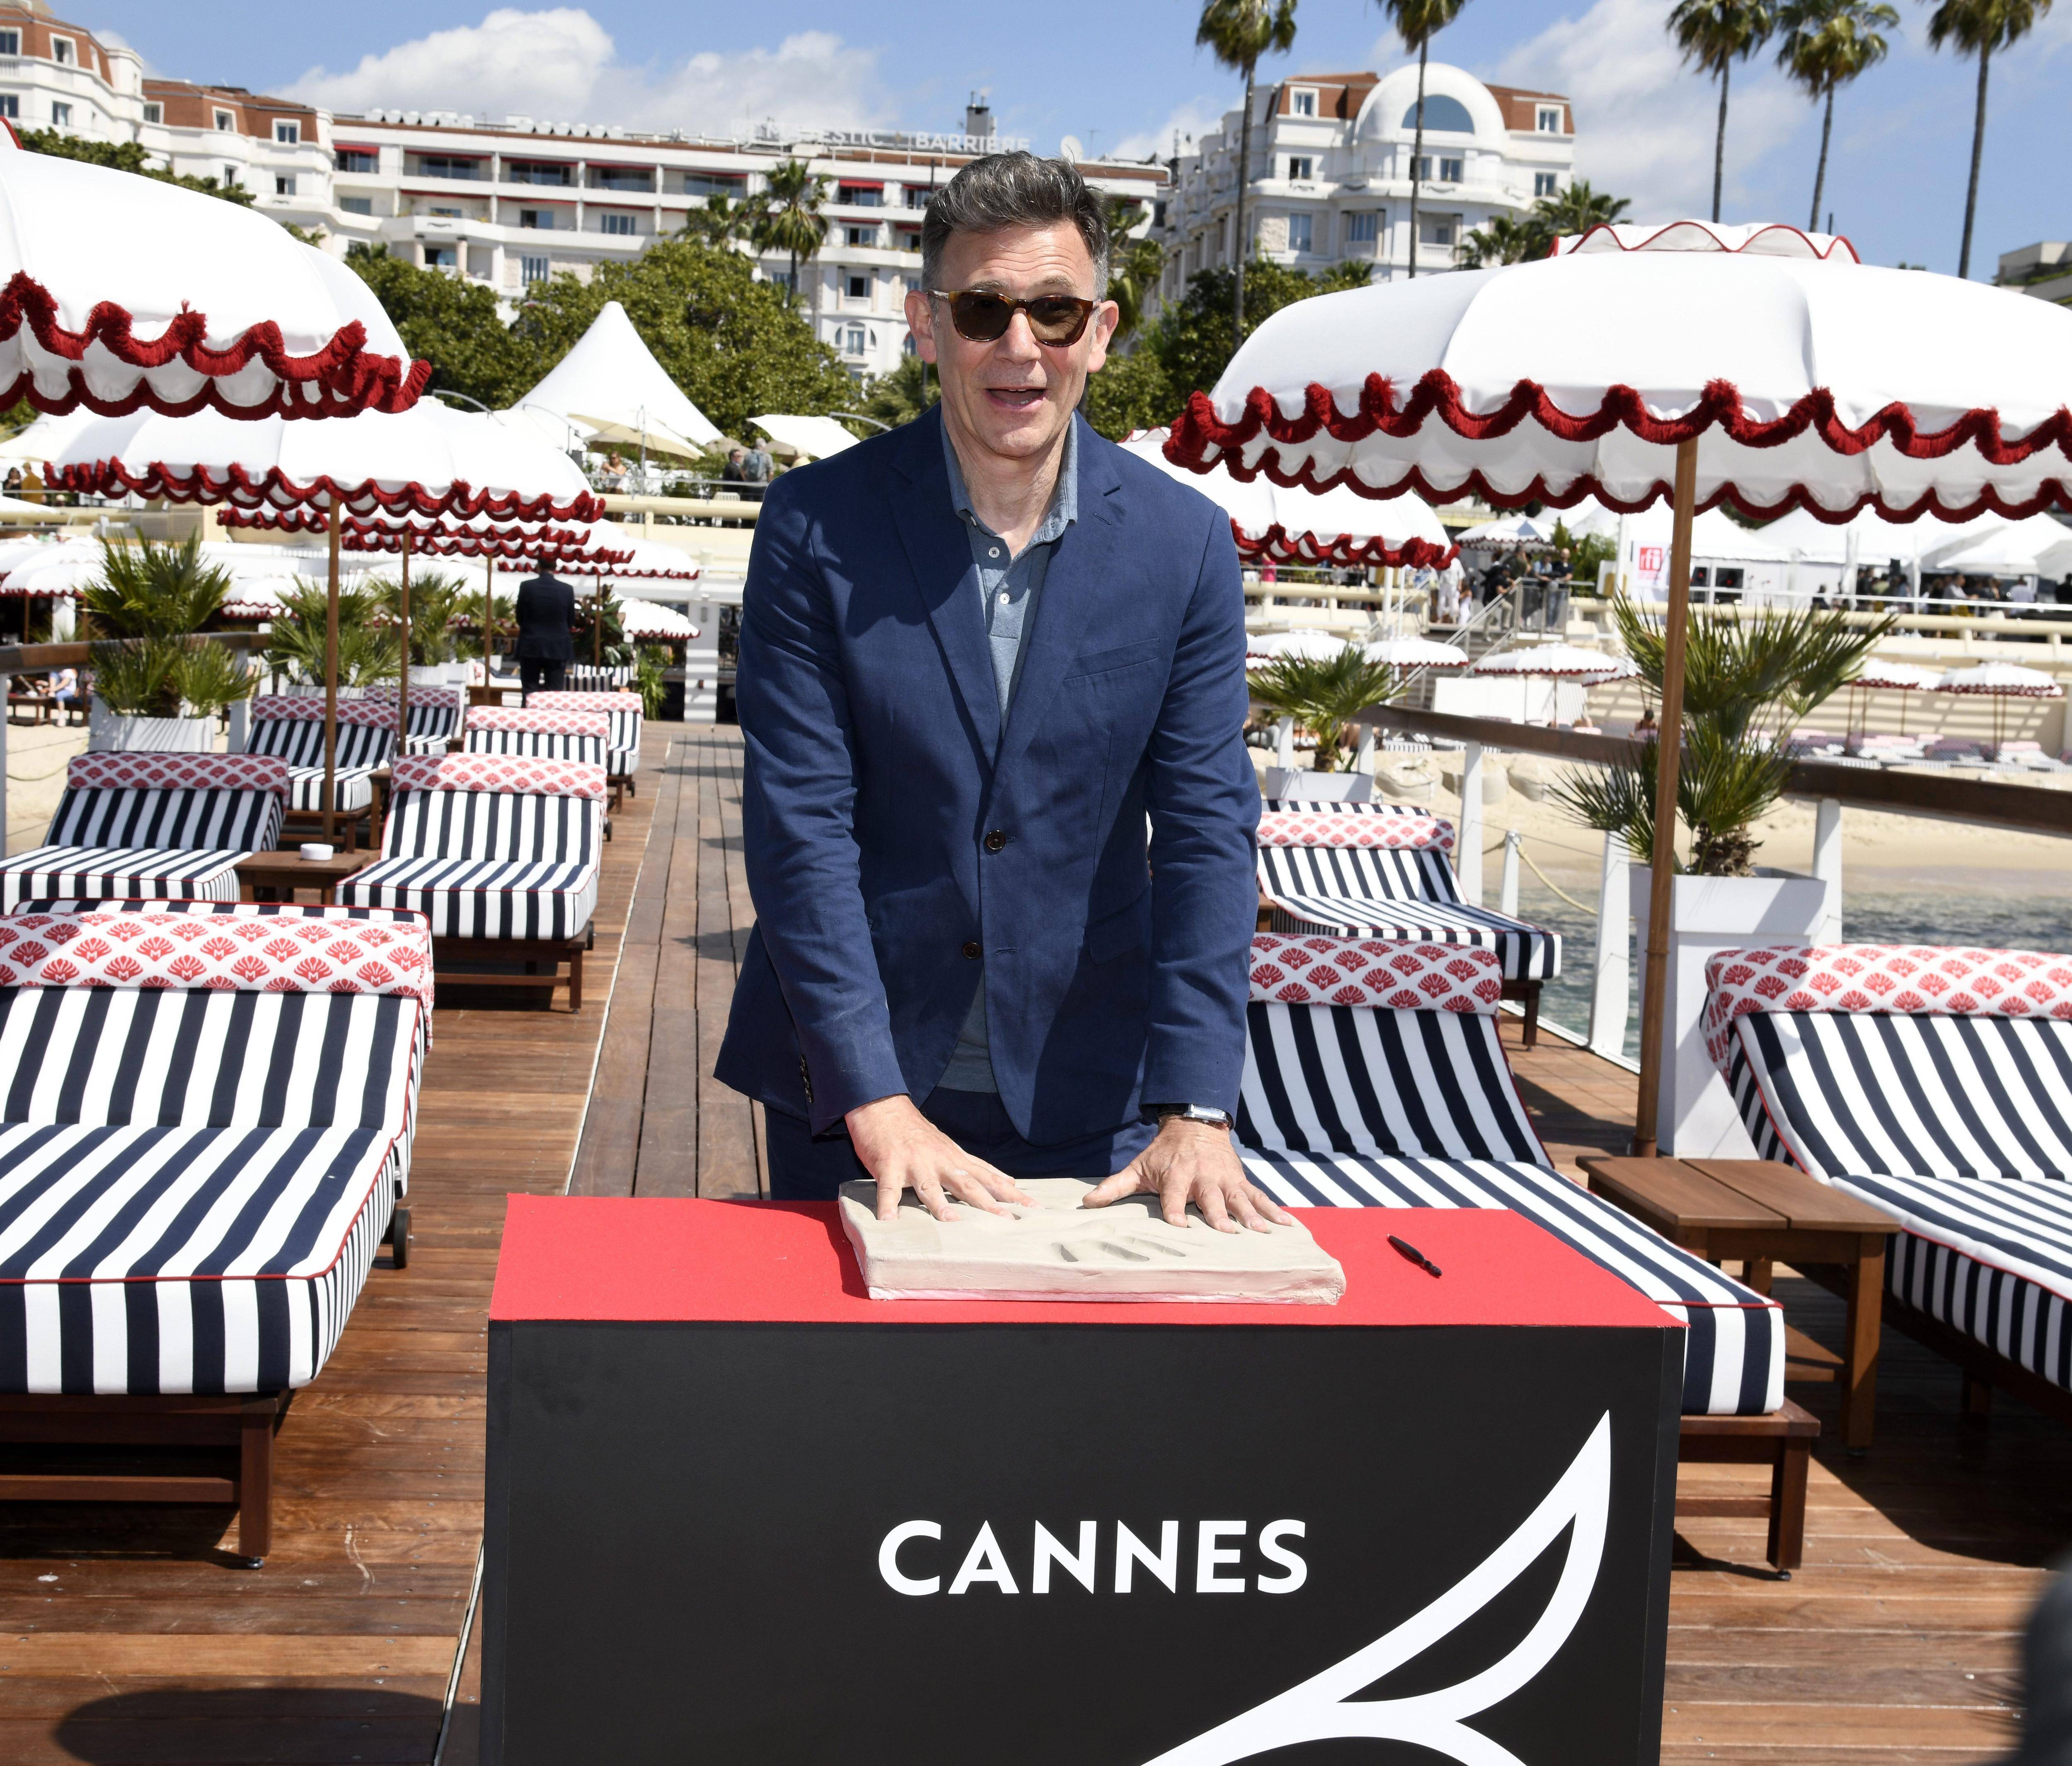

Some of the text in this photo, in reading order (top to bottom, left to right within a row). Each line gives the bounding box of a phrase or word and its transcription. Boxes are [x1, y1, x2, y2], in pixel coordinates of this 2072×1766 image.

[23, 955, 34, 964] M
[87, 951, 97, 959] M
[150, 949, 161, 957] M
[277, 951, 287, 959] M
[401, 959, 411, 968] M
[55, 973, 66, 982] M
[245, 970, 256, 978] M
[371, 975, 381, 984] M
[879, 1519, 1307, 1596] CANNES
